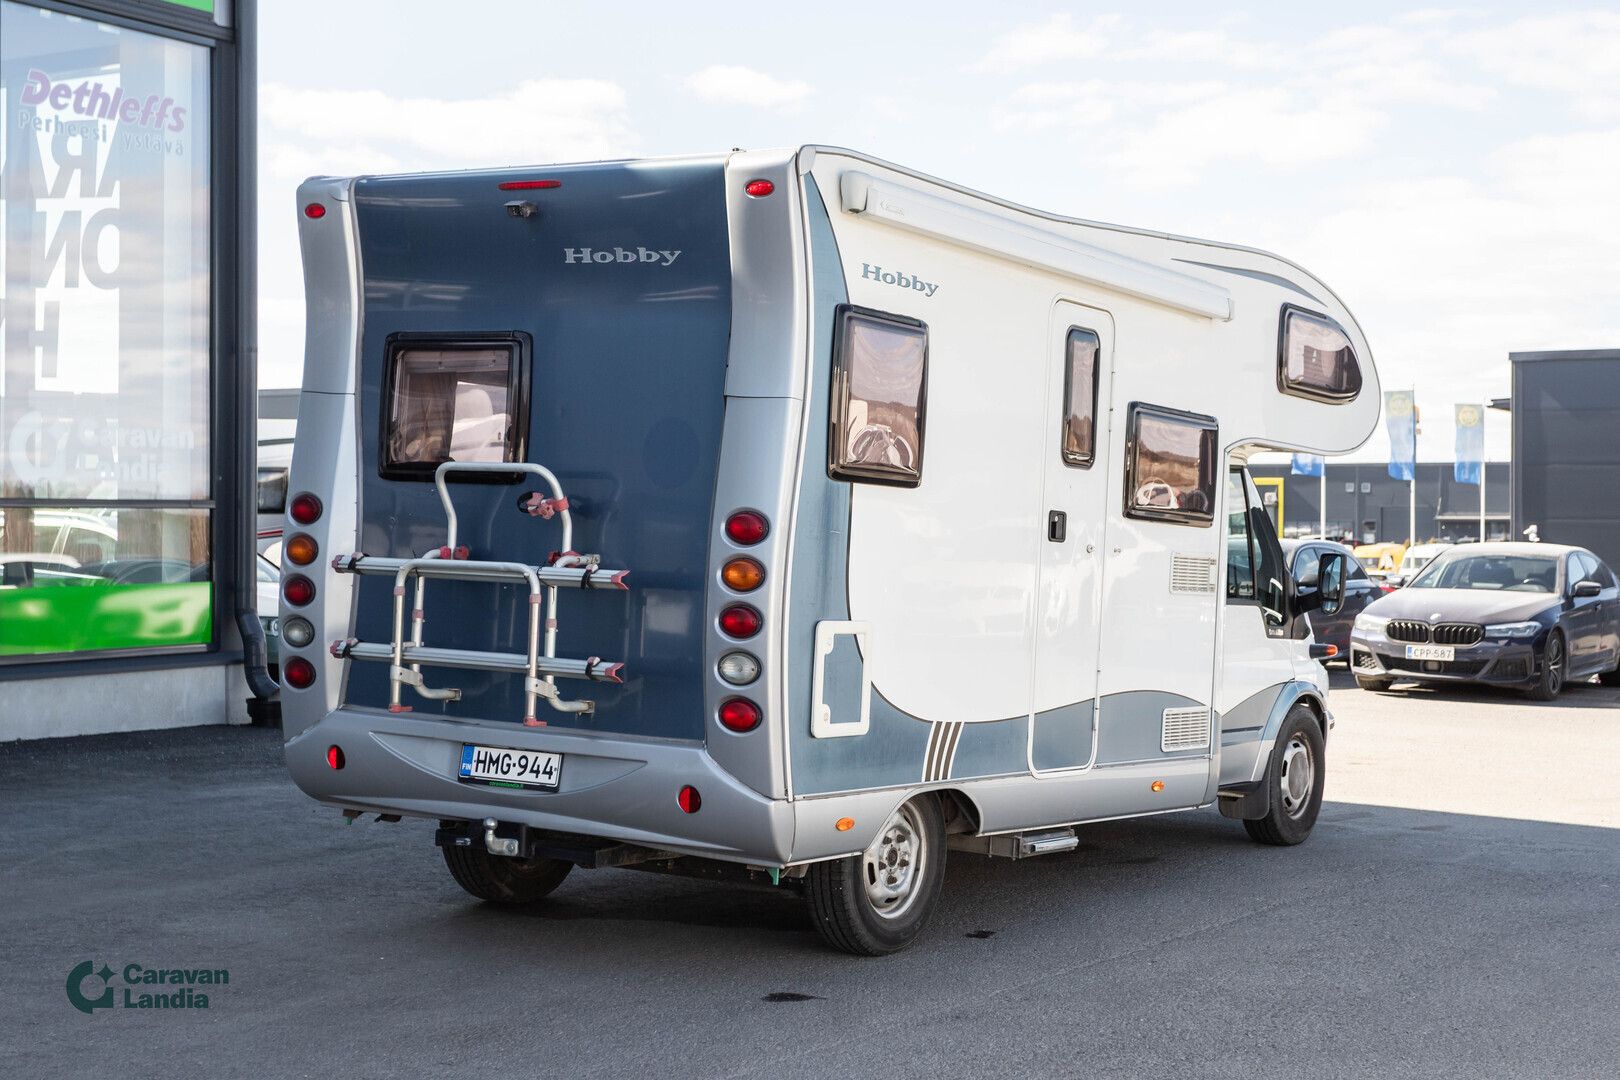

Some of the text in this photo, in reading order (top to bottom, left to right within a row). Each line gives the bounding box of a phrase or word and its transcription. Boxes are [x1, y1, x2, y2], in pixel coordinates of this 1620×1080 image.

[21, 68, 187, 133] Dethleffs
[18, 110, 108, 143] Perheesi
[564, 247, 682, 267] Hobby
[861, 262, 939, 298] Hobby
[1413, 648, 1452, 659] CPP-587
[462, 762, 472, 771] FIN
[474, 750, 554, 780] HMG-944
